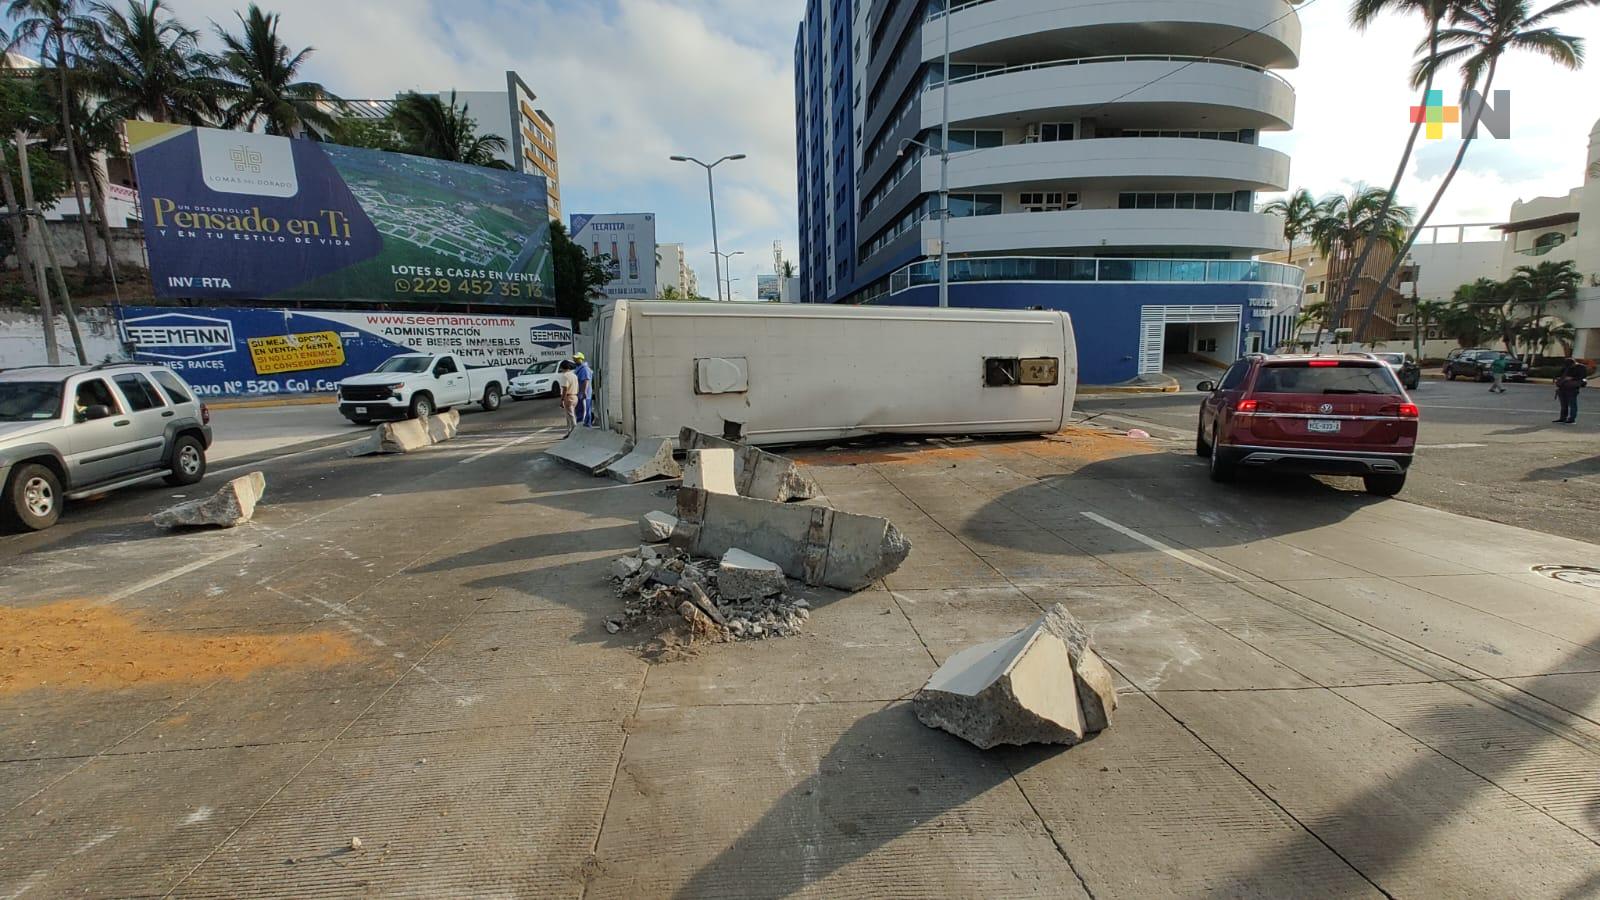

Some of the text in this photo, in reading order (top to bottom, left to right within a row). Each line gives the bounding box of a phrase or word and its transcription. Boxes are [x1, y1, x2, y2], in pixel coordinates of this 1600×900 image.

[209, 175, 242, 184] LOMAS
[257, 180, 293, 188] DORADO
[194, 205, 252, 214] DESARROLLO
[152, 197, 351, 238] Pensado en Ti
[234, 234, 285, 243] ESTILO
[320, 238, 351, 246] VIDA
[391, 264, 541, 283] LOTES & CASAS EN VENTA
[413, 277, 451, 293] 229
[458, 280, 494, 295] 452
[500, 282, 521, 297] 35
[366, 315, 515, 327] www.seemann.com.mx
[127, 328, 229, 344] SEEMANN
[384, 326, 480, 336] ADMINISTRACIÓN
[532, 331, 570, 340] SEEMANN
[266, 337, 290, 346] MEJ
[408, 337, 422, 346] DE
[427, 337, 462, 347] BIENES
[268, 346, 297, 354] VENTA
[306, 342, 333, 350] RENTA
[451, 347, 524, 356] VENTA Y RENTA
[188, 360, 224, 369] RAICES
[273, 358, 337, 369] CONSEGUIMOS
[486, 354, 537, 366] VALUACIÓN
[247, 379, 279, 393] 520
